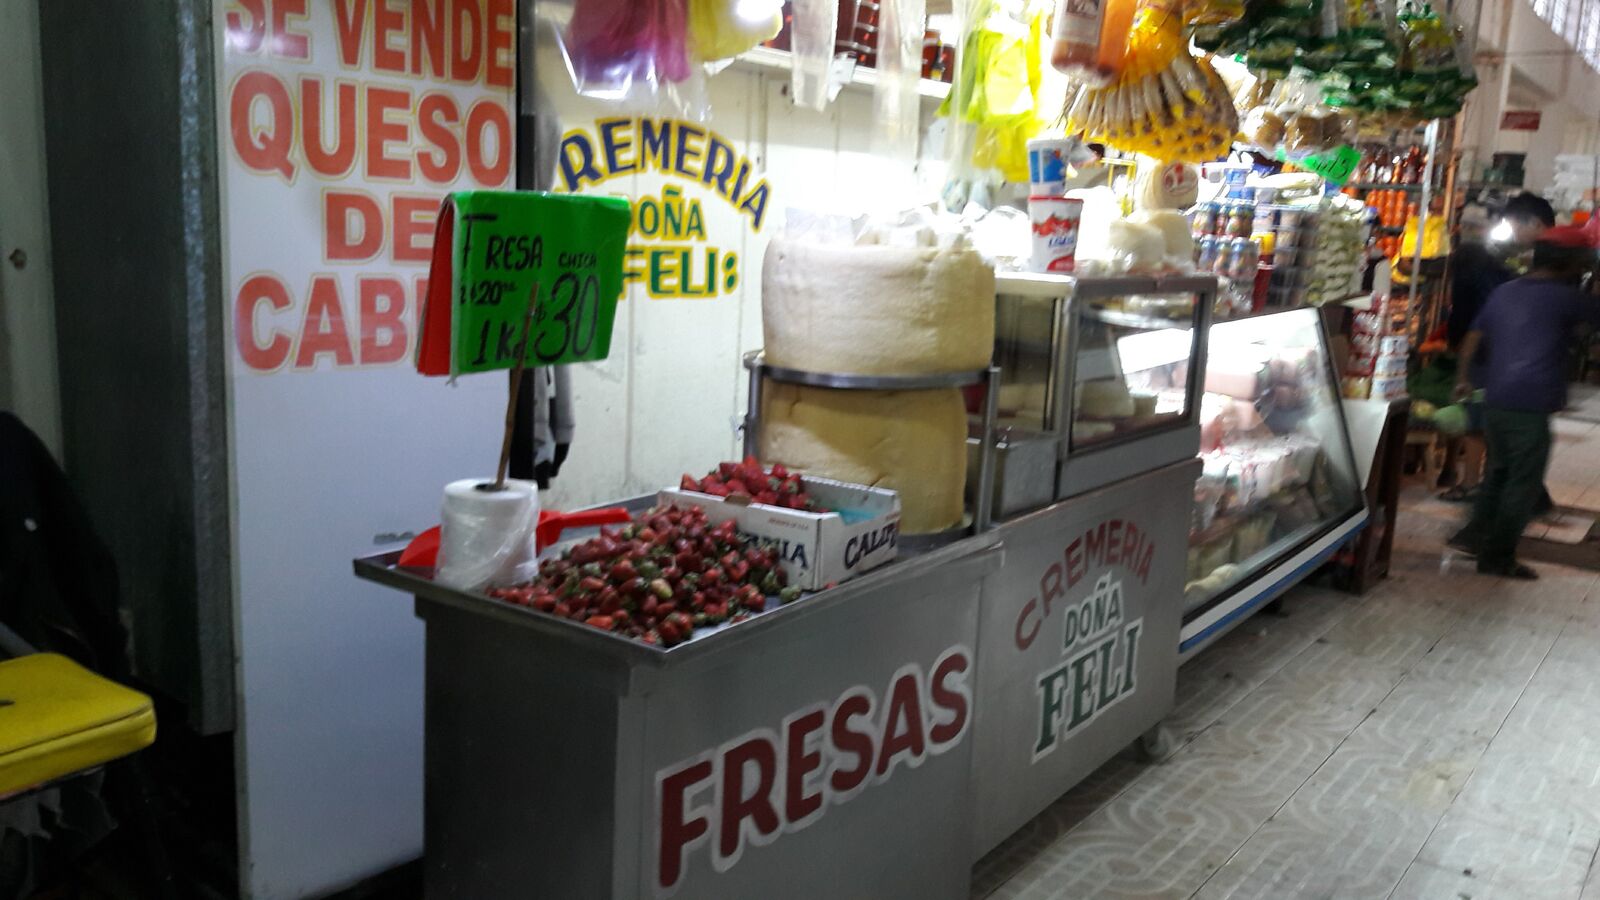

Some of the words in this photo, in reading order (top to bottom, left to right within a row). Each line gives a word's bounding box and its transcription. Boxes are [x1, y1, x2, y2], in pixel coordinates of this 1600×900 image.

[226, 0, 309, 58] SE
[335, 0, 514, 87] VENDE
[230, 71, 512, 187] QUESO
[559, 118, 769, 229] REMERIA
[326, 192, 441, 261] DE
[638, 188, 705, 237] OÑA
[235, 275, 430, 371] CAB
[1015, 519, 1155, 652] CREMERIA
[1064, 581, 1122, 649] DOÑA
[1035, 623, 1142, 753] FELI
[659, 653, 969, 888] FRESAS
